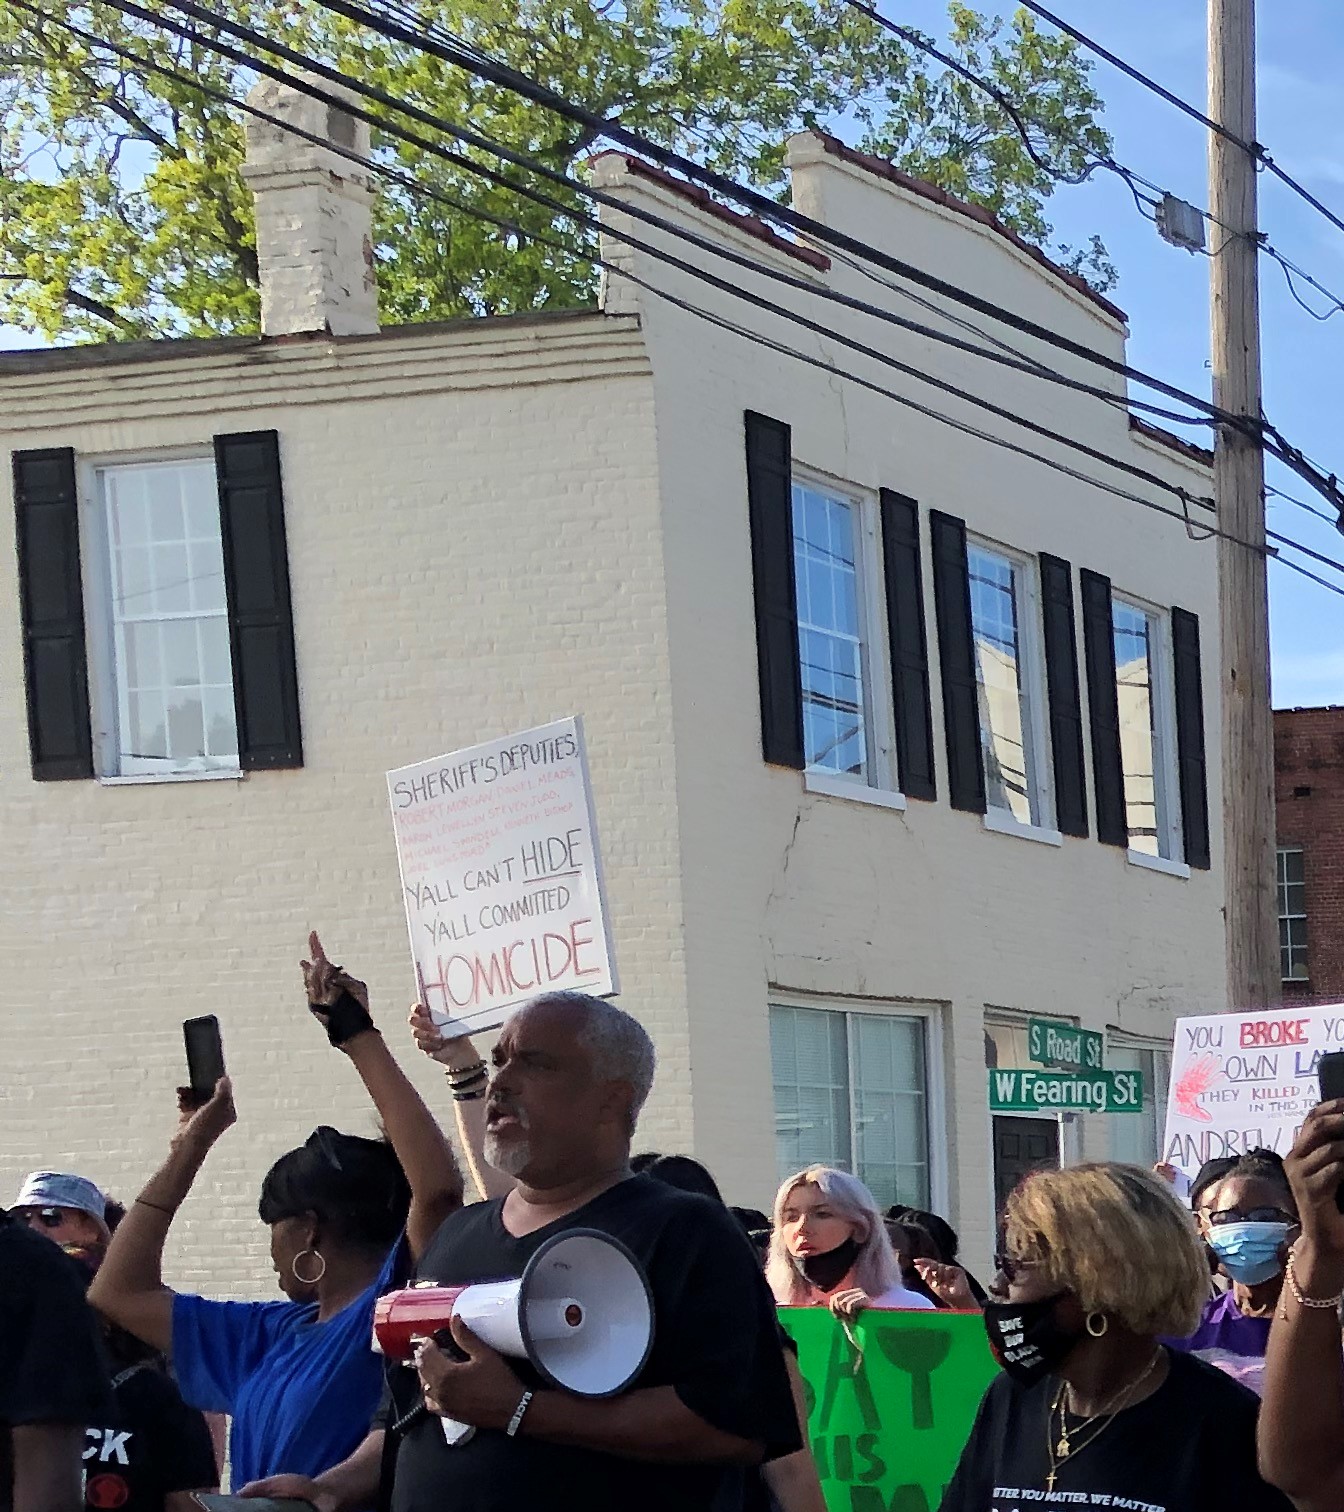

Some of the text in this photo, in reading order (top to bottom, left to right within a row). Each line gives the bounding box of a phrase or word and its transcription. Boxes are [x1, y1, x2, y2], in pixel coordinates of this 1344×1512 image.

[394, 757, 498, 808] SHERIFF'S
[406, 828, 583, 911] Y'ALL CAN'T HIDE
[424, 886, 570, 947] Y'ALL COMMITTED
[417, 918, 600, 1016] HOMICIDE
[1031, 1025, 1101, 1068] S Road St
[1186, 1026, 1223, 1051] YOU
[1240, 1018, 1311, 1048] BROKE
[1225, 1053, 1278, 1079] OWN
[995, 1072, 1138, 1112] W Fearing St
[1200, 1089, 1240, 1103] THEY
[1252, 1086, 1300, 1100] KILLED
[1249, 1103, 1264, 1112] IN
[1269, 1101, 1298, 1111] THIS
[1168, 1127, 1282, 1167] ANDREW
[1021, 1489, 1045, 1501] YOU
[1090, 1493, 1112, 1506] WE
